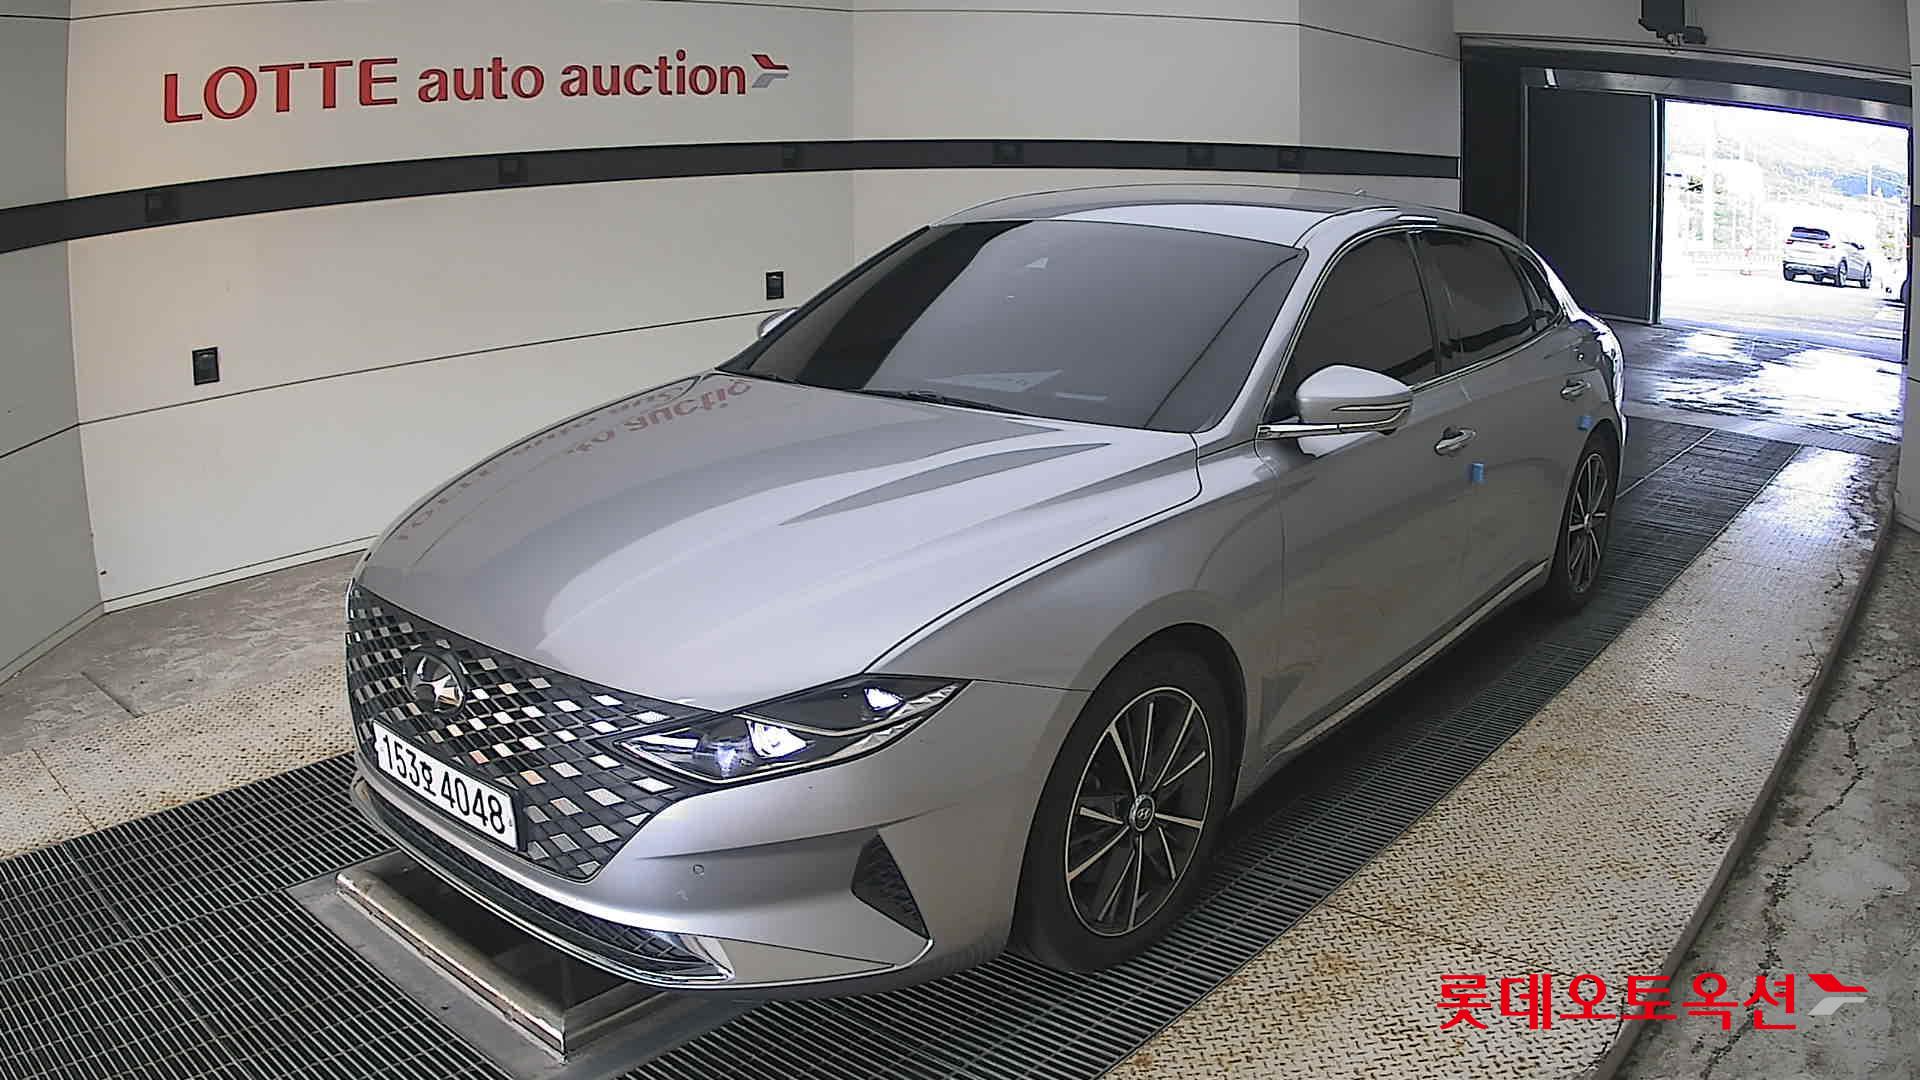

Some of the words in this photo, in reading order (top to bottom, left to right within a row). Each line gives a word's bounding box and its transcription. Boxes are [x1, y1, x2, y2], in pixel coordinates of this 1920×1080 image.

[163, 57, 399, 124] LOTTE
[416, 55, 546, 103] auto
[559, 49, 747, 97] auction
[383, 734, 437, 797] 153호
[440, 770, 506, 835] 4048
